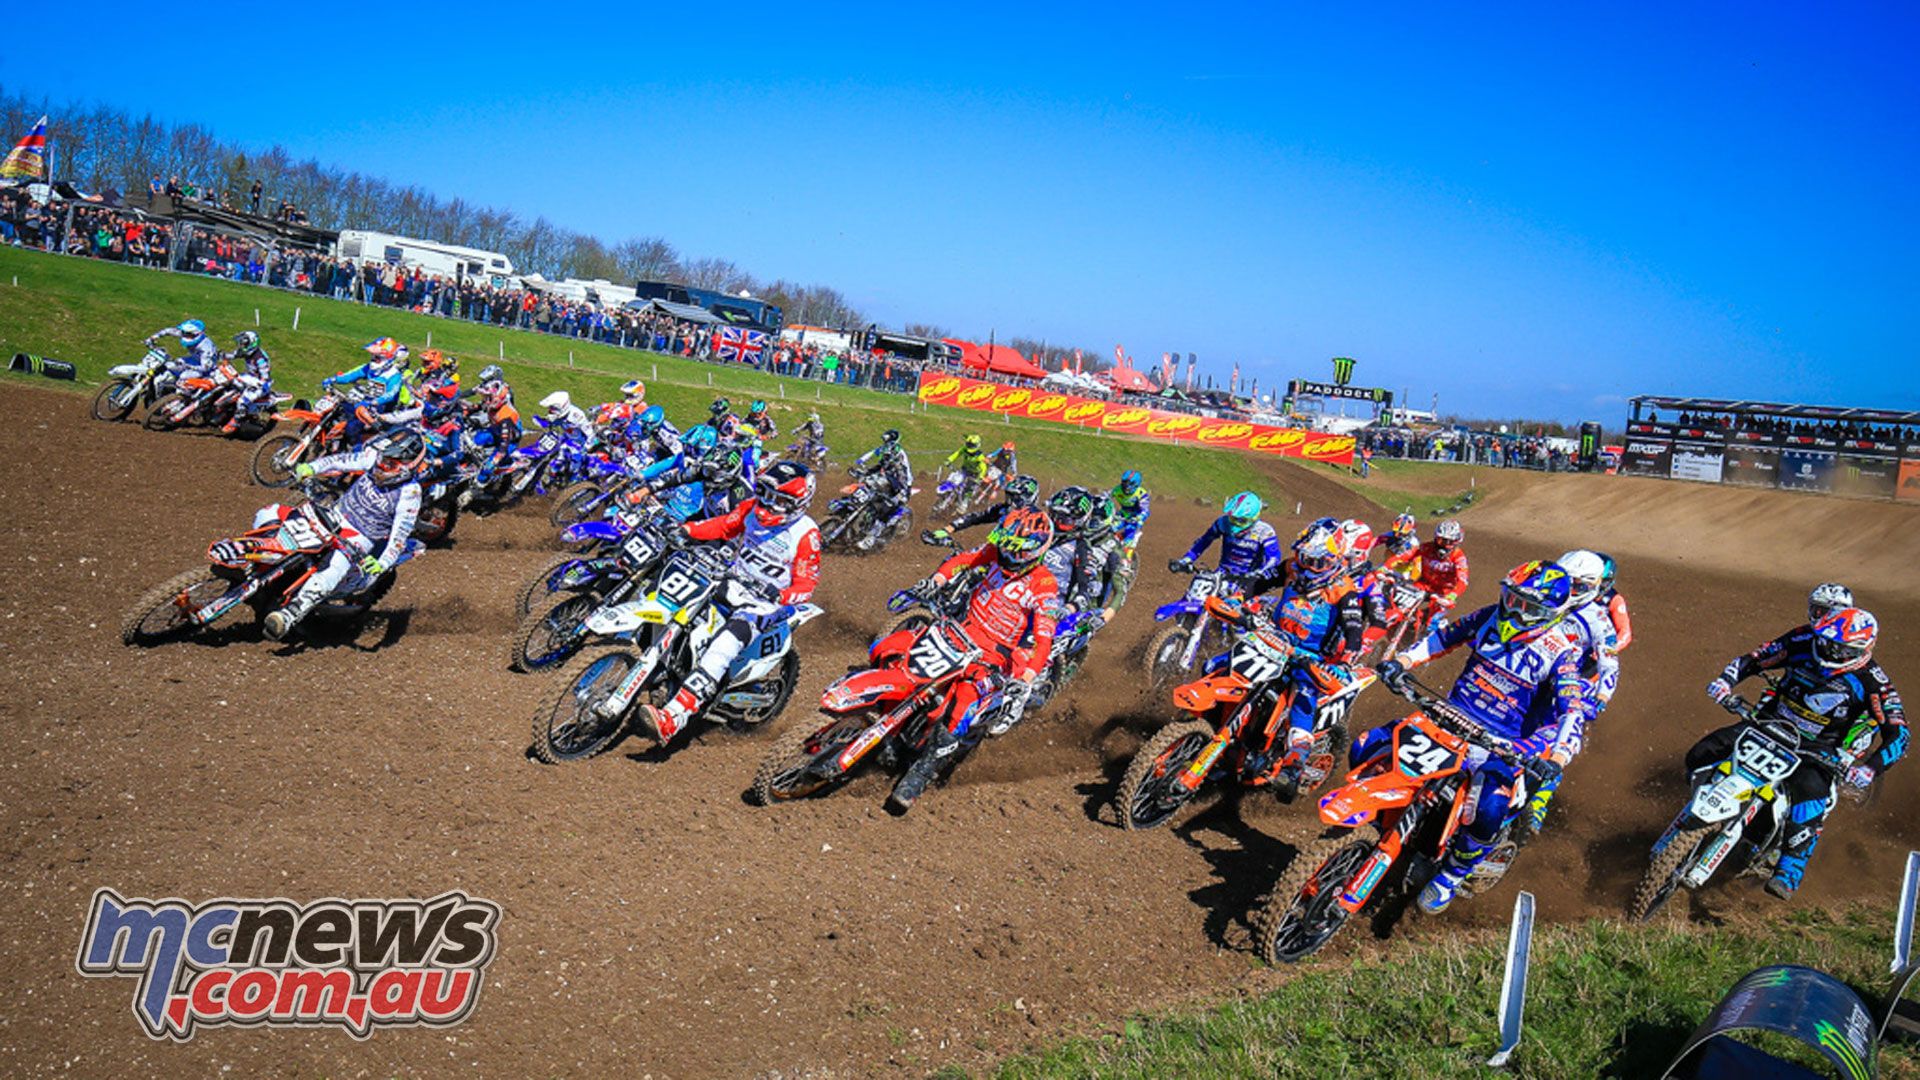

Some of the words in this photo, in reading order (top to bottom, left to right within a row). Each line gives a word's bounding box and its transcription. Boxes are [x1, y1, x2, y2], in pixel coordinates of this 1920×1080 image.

[1305, 384, 1372, 399] PADDOCK
[284, 517, 325, 549] 211
[624, 535, 653, 564] 60
[660, 571, 699, 603] 81
[760, 632, 782, 658] 81
[909, 638, 953, 679] 720
[1397, 733, 1451, 775] 24
[1737, 740, 1789, 780] 303
